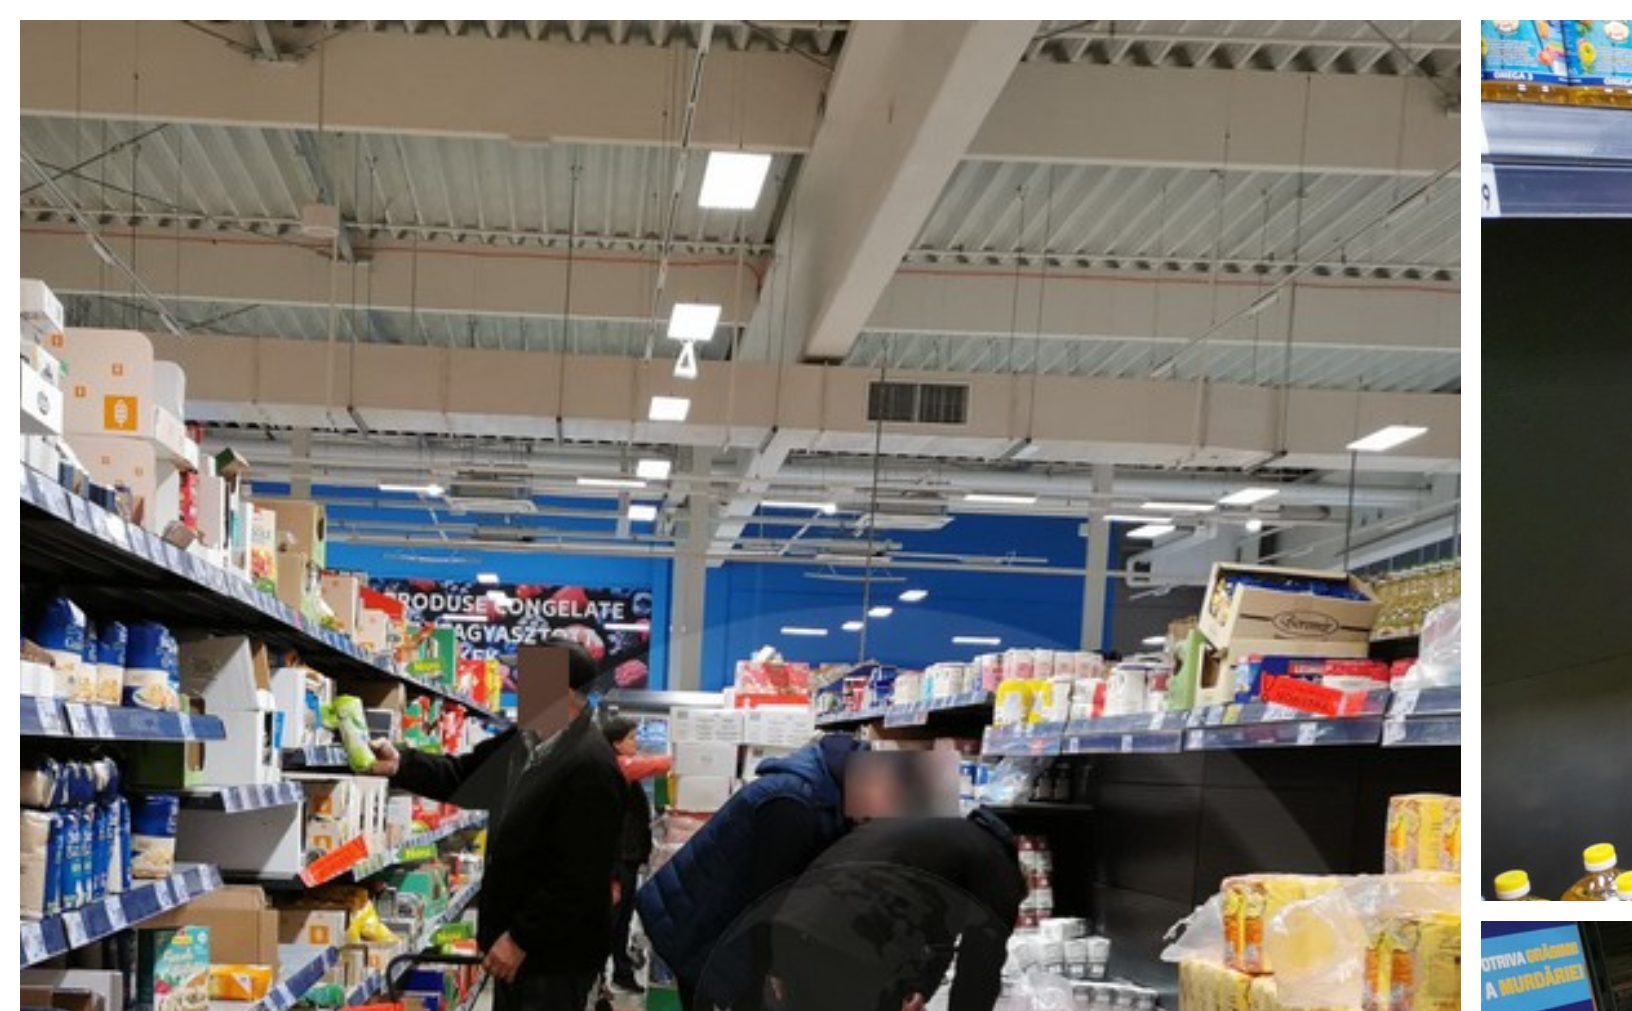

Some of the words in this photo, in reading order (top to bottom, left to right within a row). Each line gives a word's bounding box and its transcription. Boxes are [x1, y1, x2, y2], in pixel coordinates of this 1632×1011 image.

[1493, 71, 1526, 80] OMEGA
[1603, 77, 1632, 87] OMEGA
[1485, 980, 1499, 1001] A
